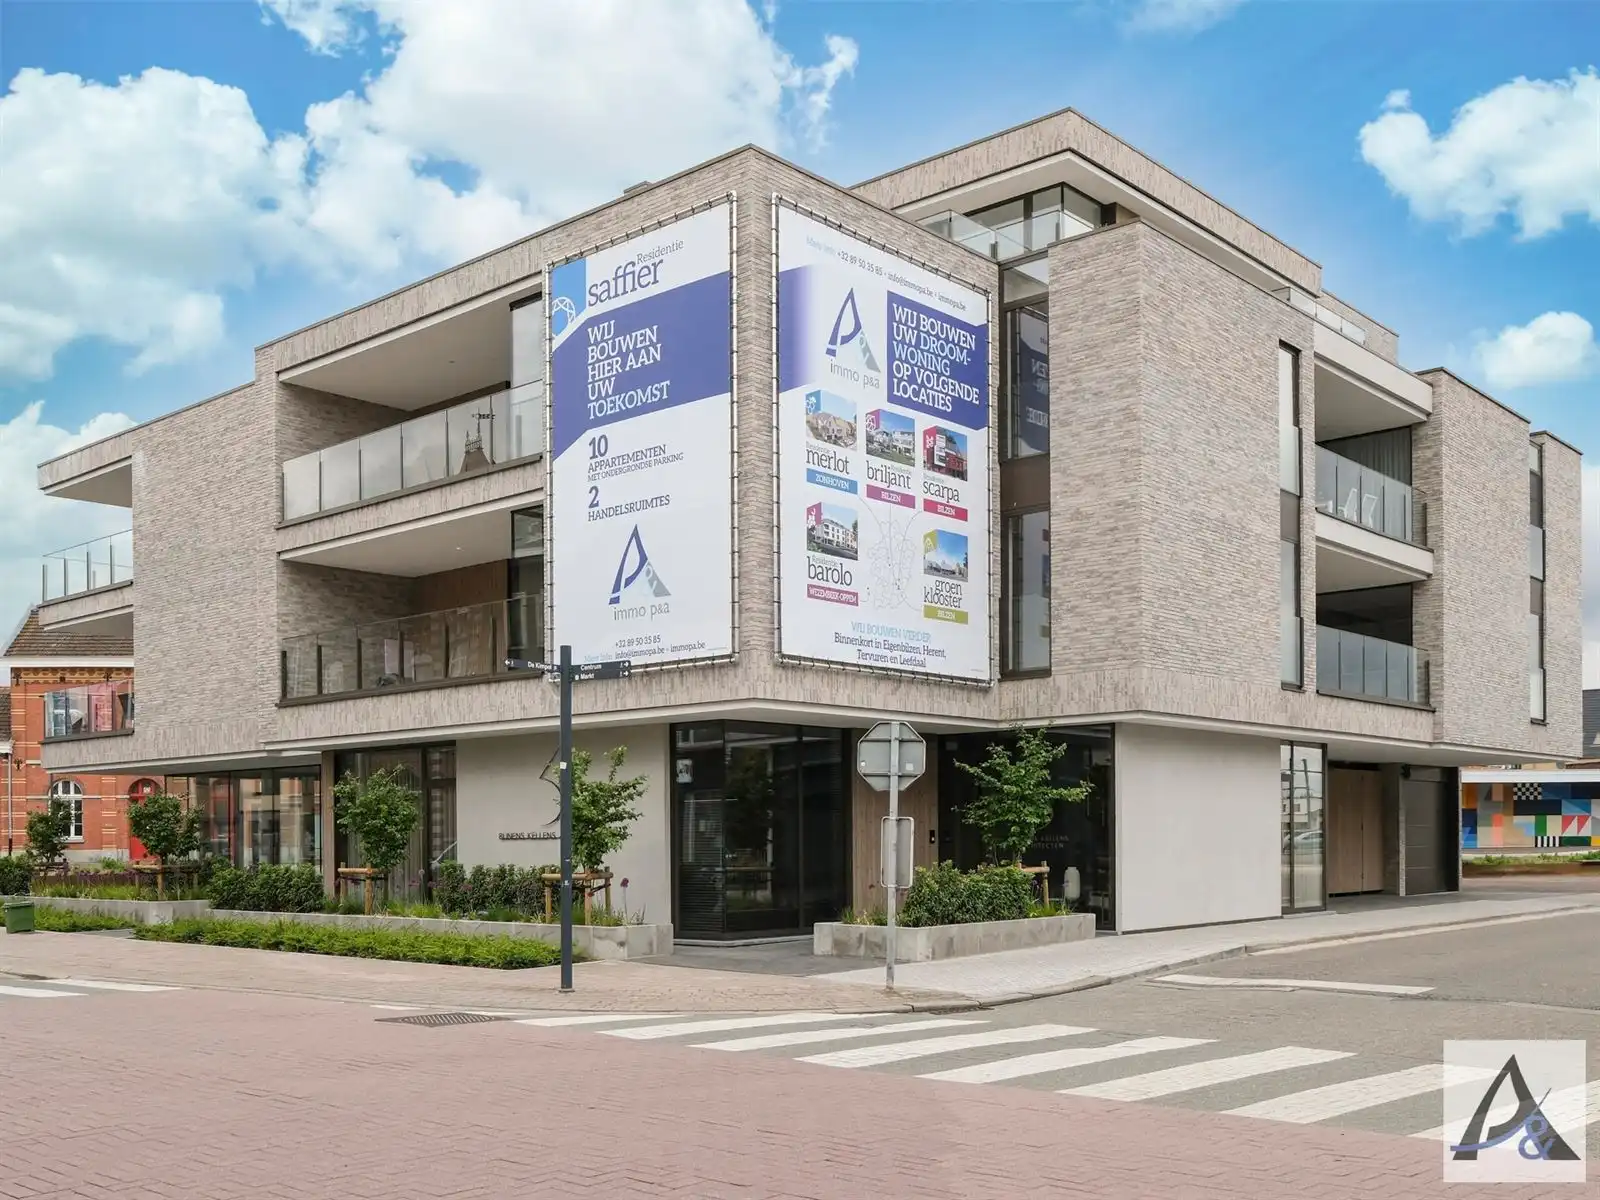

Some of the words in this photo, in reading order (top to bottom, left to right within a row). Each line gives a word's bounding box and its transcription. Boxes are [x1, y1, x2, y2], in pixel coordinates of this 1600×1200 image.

[636, 239, 684, 265] Residentie
[850, 257, 858, 266] 89
[858, 259, 866, 269] 50
[867, 264, 875, 273] 35
[875, 267, 883, 276] 85
[588, 258, 664, 307] saffier
[587, 320, 615, 344] WIJ
[893, 303, 918, 328] WIJ
[920, 314, 976, 351] BOUWEN
[587, 325, 658, 364] BOUWEN
[893, 322, 918, 346] UW
[920, 333, 972, 365] DROOM-
[587, 357, 622, 383] HIER
[625, 344, 661, 371] AAN
[893, 341, 950, 376] WONING
[830, 359, 860, 382] immo
[863, 374, 880, 389] p&a
[893, 361, 912, 380] OP
[914, 367, 980, 405] VOLGENDE
[587, 377, 615, 401] UW
[587, 380, 670, 420] TOEKOMST
[893, 379, 952, 412] LOCATIES
[587, 444, 667, 474] APPARTEMENTEN
[588, 434, 609, 460] 10
[587, 473, 601, 482] MET
[653, 452, 684, 467] PARKING
[806, 449, 850, 475] merlot
[866, 460, 912, 489] briljant
[588, 486, 600, 509] 2
[923, 480, 960, 503] scarpa
[587, 494, 671, 522] HANDELSRUIMTES
[807, 556, 853, 587] barolo
[923, 586, 963, 609] klooster
[935, 579, 963, 596] groen
[613, 606, 646, 621] immo
[650, 602, 670, 622] p&a
[626, 638, 635, 647] 89
[635, 637, 643, 645] 50
[643, 636, 652, 645] 35
[652, 634, 661, 643] 85
[866, 624, 901, 639] BOUWEN
[670, 640, 706, 653] immopa.be
[834, 632, 874, 649] Binnenkort
[875, 640, 882, 648] in
[922, 645, 947, 659] Herent,
[857, 649, 889, 663] Tervuren
[890, 655, 899, 664] en
[580, 664, 602, 672] Centrum
[580, 673, 595, 681] Markt
